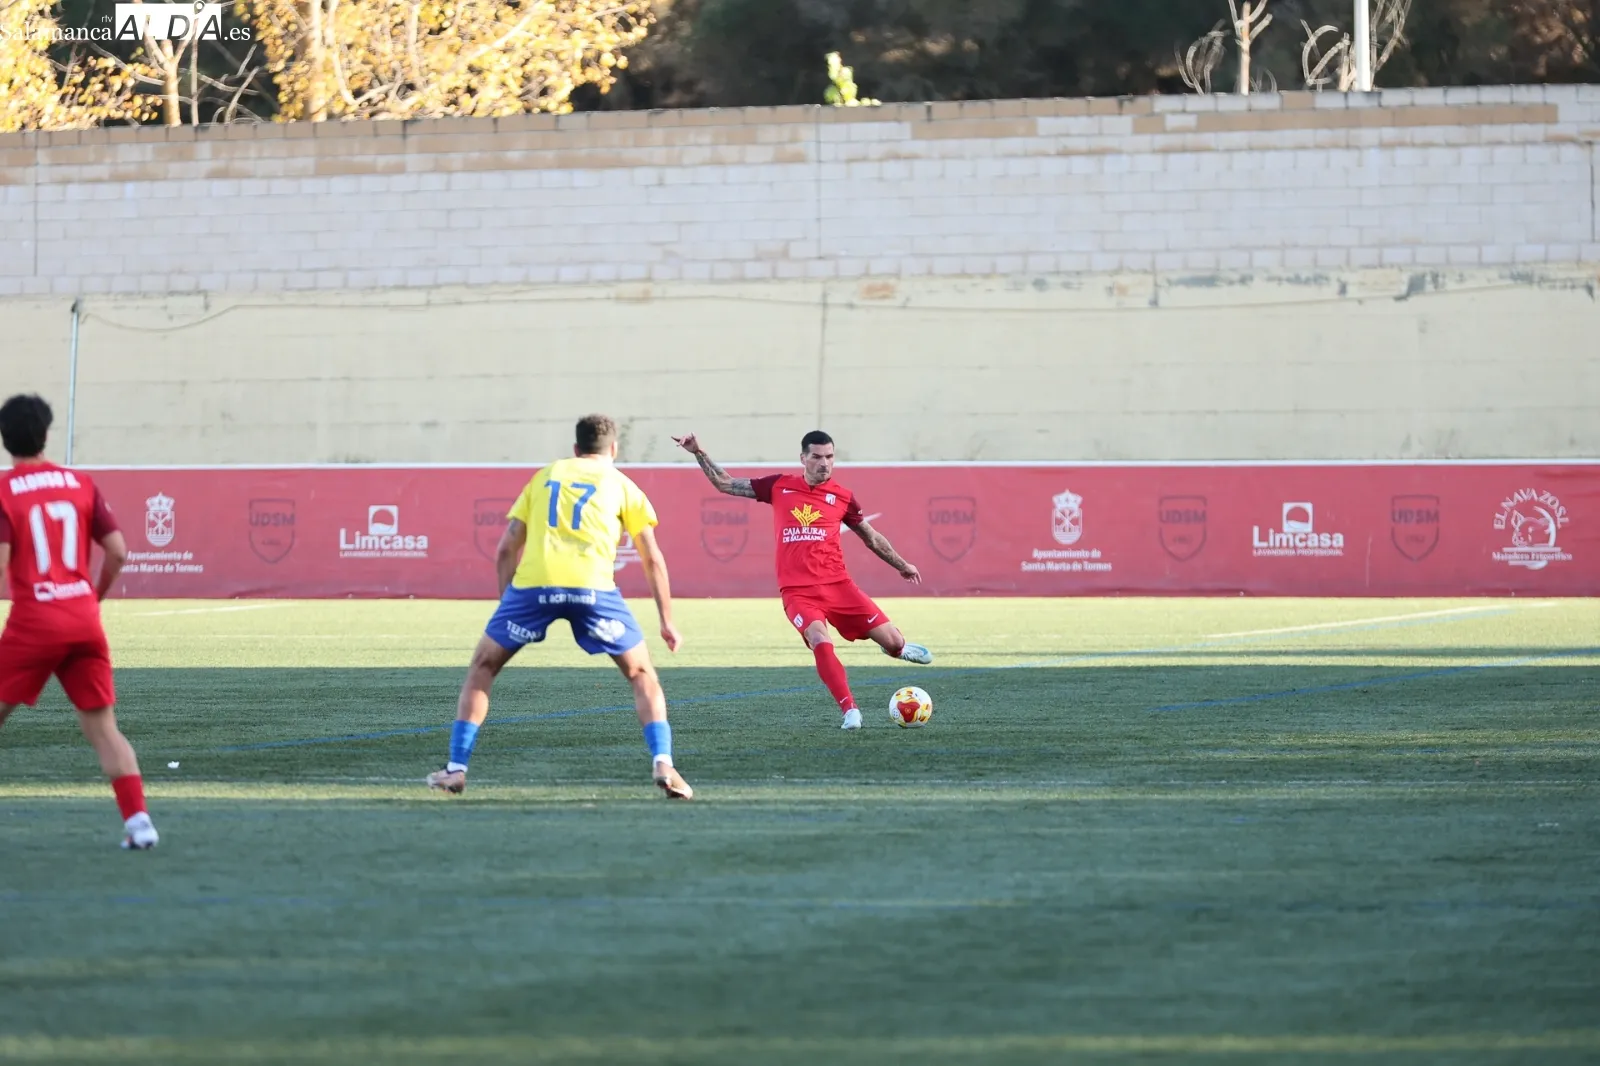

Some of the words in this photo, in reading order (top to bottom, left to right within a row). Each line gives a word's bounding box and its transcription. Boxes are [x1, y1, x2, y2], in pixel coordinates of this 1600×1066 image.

[544, 479, 597, 530] 17
[250, 512, 295, 527] UDSM
[475, 511, 508, 526] UDS
[929, 511, 974, 525] UDSM
[1160, 510, 1207, 524] UDSM
[1392, 509, 1439, 523] UDSM
[29, 501, 78, 575] 17
[339, 528, 428, 550] Limcasa
[783, 527, 800, 536] CAJA
[802, 527, 828, 537] RURAL
[1253, 525, 1344, 548] Limcasa
[127, 551, 181, 562] Ayuntamiento
[182, 551, 193, 560] de
[1032, 548, 1090, 560] Ayuntamiento
[1091, 548, 1101, 558] de
[140, 563, 164, 573] Marta
[165, 563, 175, 573] de
[175, 563, 204, 573] Tormes
[1021, 561, 1046, 571] Santa
[1047, 561, 1071, 571] Marta
[1072, 561, 1082, 571] de
[1083, 561, 1112, 571] Tormes
